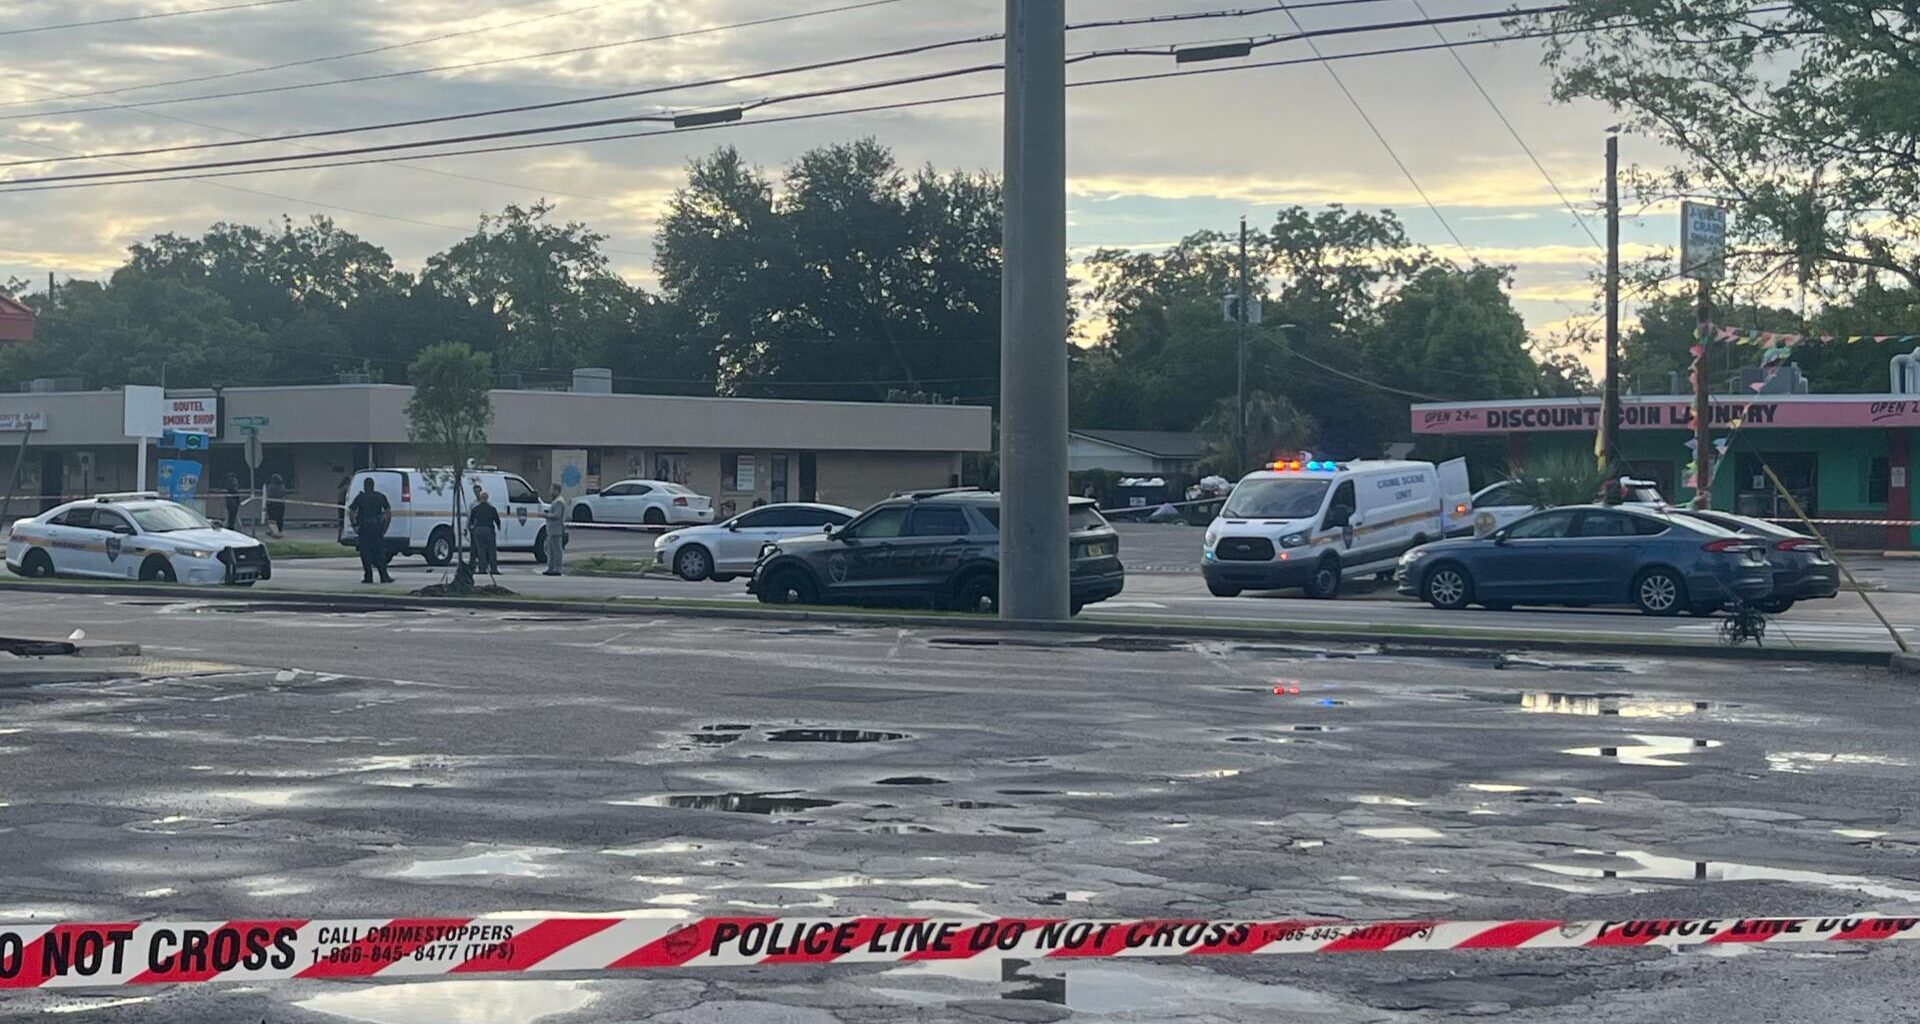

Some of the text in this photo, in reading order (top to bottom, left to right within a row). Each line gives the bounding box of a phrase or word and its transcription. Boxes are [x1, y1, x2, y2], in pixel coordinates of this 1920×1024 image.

[173, 401, 204, 412] SOUTEL
[1870, 401, 1906, 414] OPEN
[163, 414, 192, 426] SMOKE
[193, 413, 215, 425] SHOP
[1424, 410, 1452, 425] OPEN
[1487, 407, 1601, 428] DISCOUNT
[1377, 473, 1426, 490] CRIME SCENE
[1395, 489, 1413, 500] UNIT
[317, 924, 515, 945] CALL CRIMESTOPPERS
[710, 921, 856, 957] POLICE
[868, 921, 965, 954] LINE
[968, 921, 1026, 951] DO
[1034, 922, 1120, 950] NOT
[1125, 921, 1257, 948] CROSS
[41, 929, 134, 977] NOT
[147, 927, 299, 974] CROSS
[464, 942, 515, 964] (TIPS)
